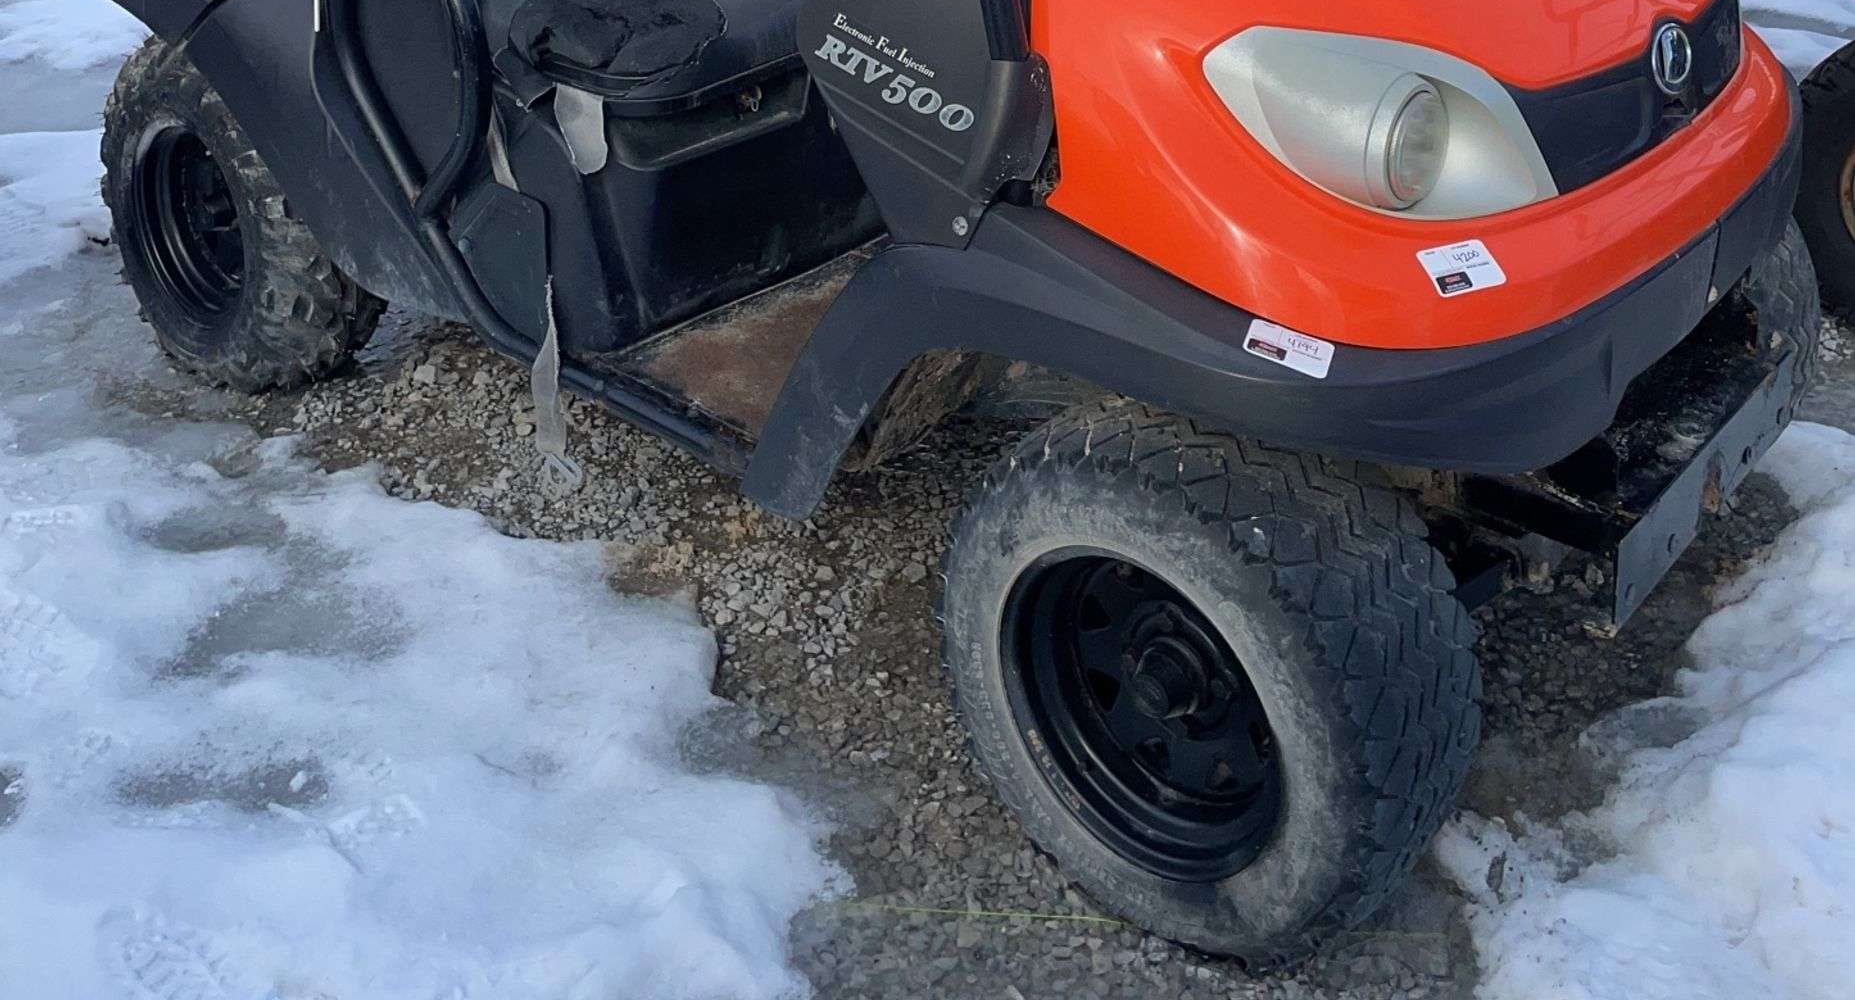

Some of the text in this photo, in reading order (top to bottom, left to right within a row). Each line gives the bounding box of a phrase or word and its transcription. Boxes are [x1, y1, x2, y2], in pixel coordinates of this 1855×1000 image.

[833, 12, 936, 79] Electronic Fuel Injection
